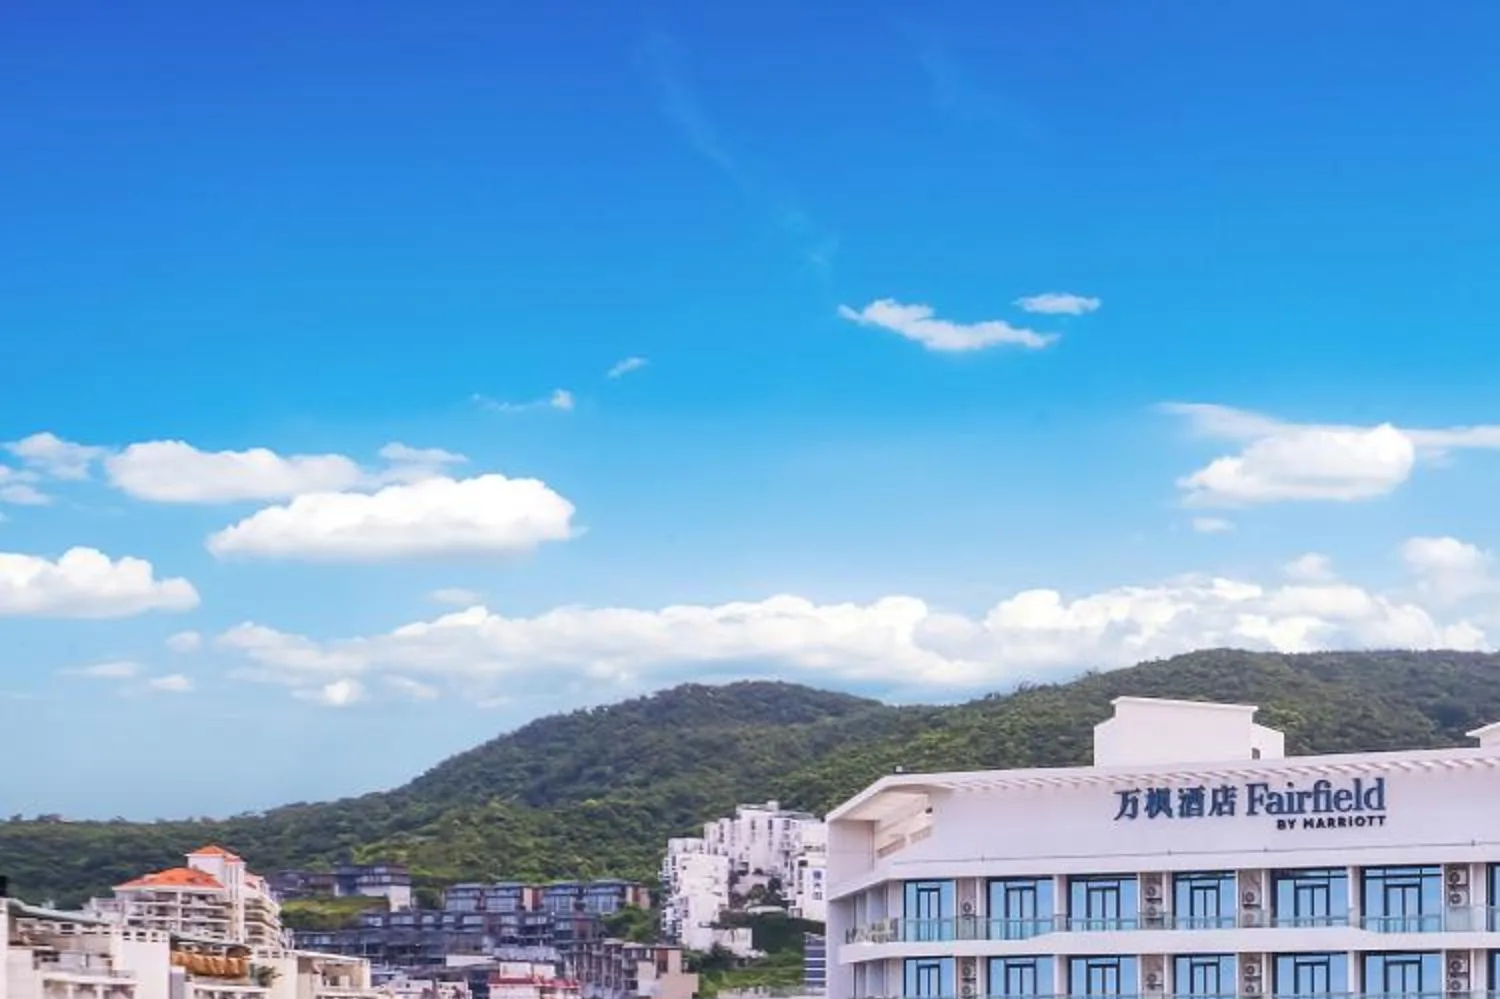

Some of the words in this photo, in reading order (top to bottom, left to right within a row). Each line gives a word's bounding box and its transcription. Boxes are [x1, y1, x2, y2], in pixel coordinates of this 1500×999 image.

[1113, 784, 1238, 820] 万枫酒店
[1246, 777, 1385, 817] Fairfield
[1277, 819, 1297, 830] BY
[1303, 815, 1387, 829] MARRIOTT
